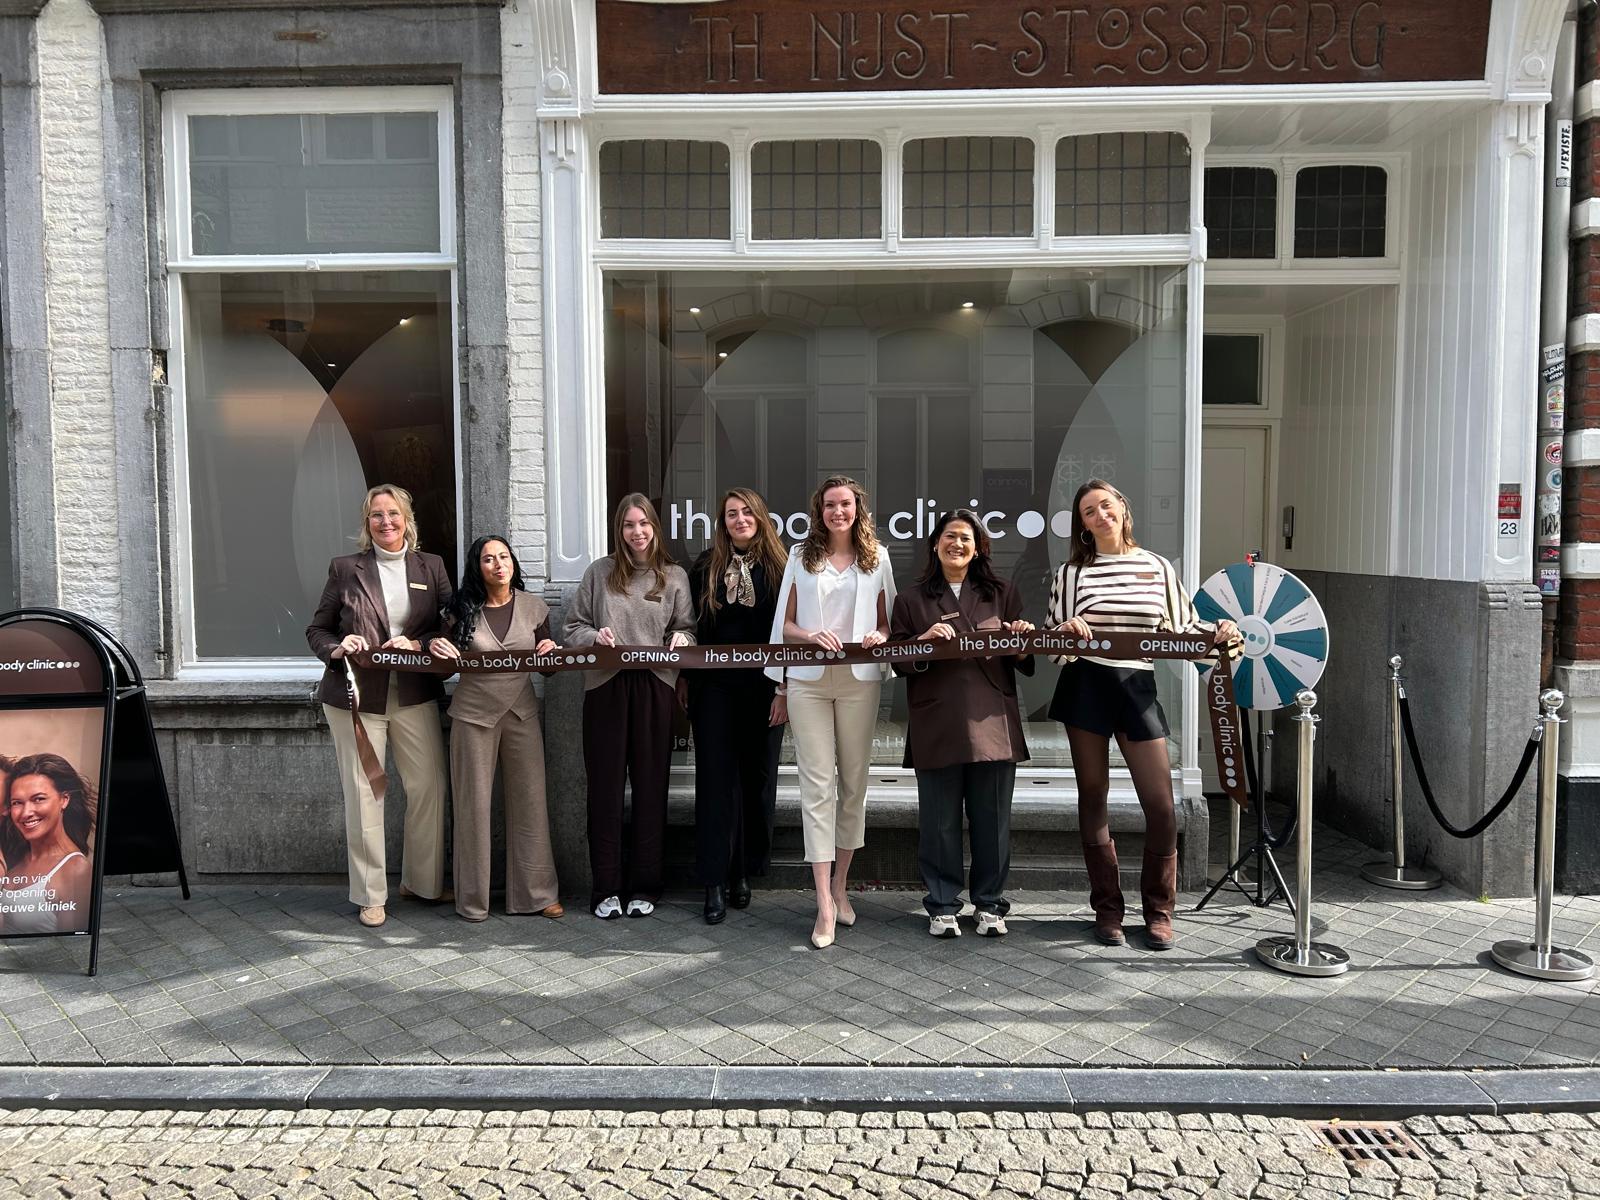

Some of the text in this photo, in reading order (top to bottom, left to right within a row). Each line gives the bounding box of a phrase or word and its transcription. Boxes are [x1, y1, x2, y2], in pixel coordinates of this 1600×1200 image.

[690, 12, 765, 83] TH
[671, 498, 1006, 540] th clic
[1500, 522, 1517, 535] 23
[959, 633, 1075, 651] the body clinic
[1140, 640, 1207, 653] OPENING
[621, 651, 680, 663] OPENING
[705, 648, 813, 665] the body clinic
[872, 643, 934, 658] OPENING
[26, 659, 56, 670] clinic
[372, 653, 432, 666] OPENING
[455, 653, 563, 671] the body clinic
[1212, 675, 1232, 714] body
[1218, 717, 1237, 755] clinic
[12, 876, 28, 885] en
[6, 888, 56, 902] opening
[38, 901, 77, 912] kliniek
